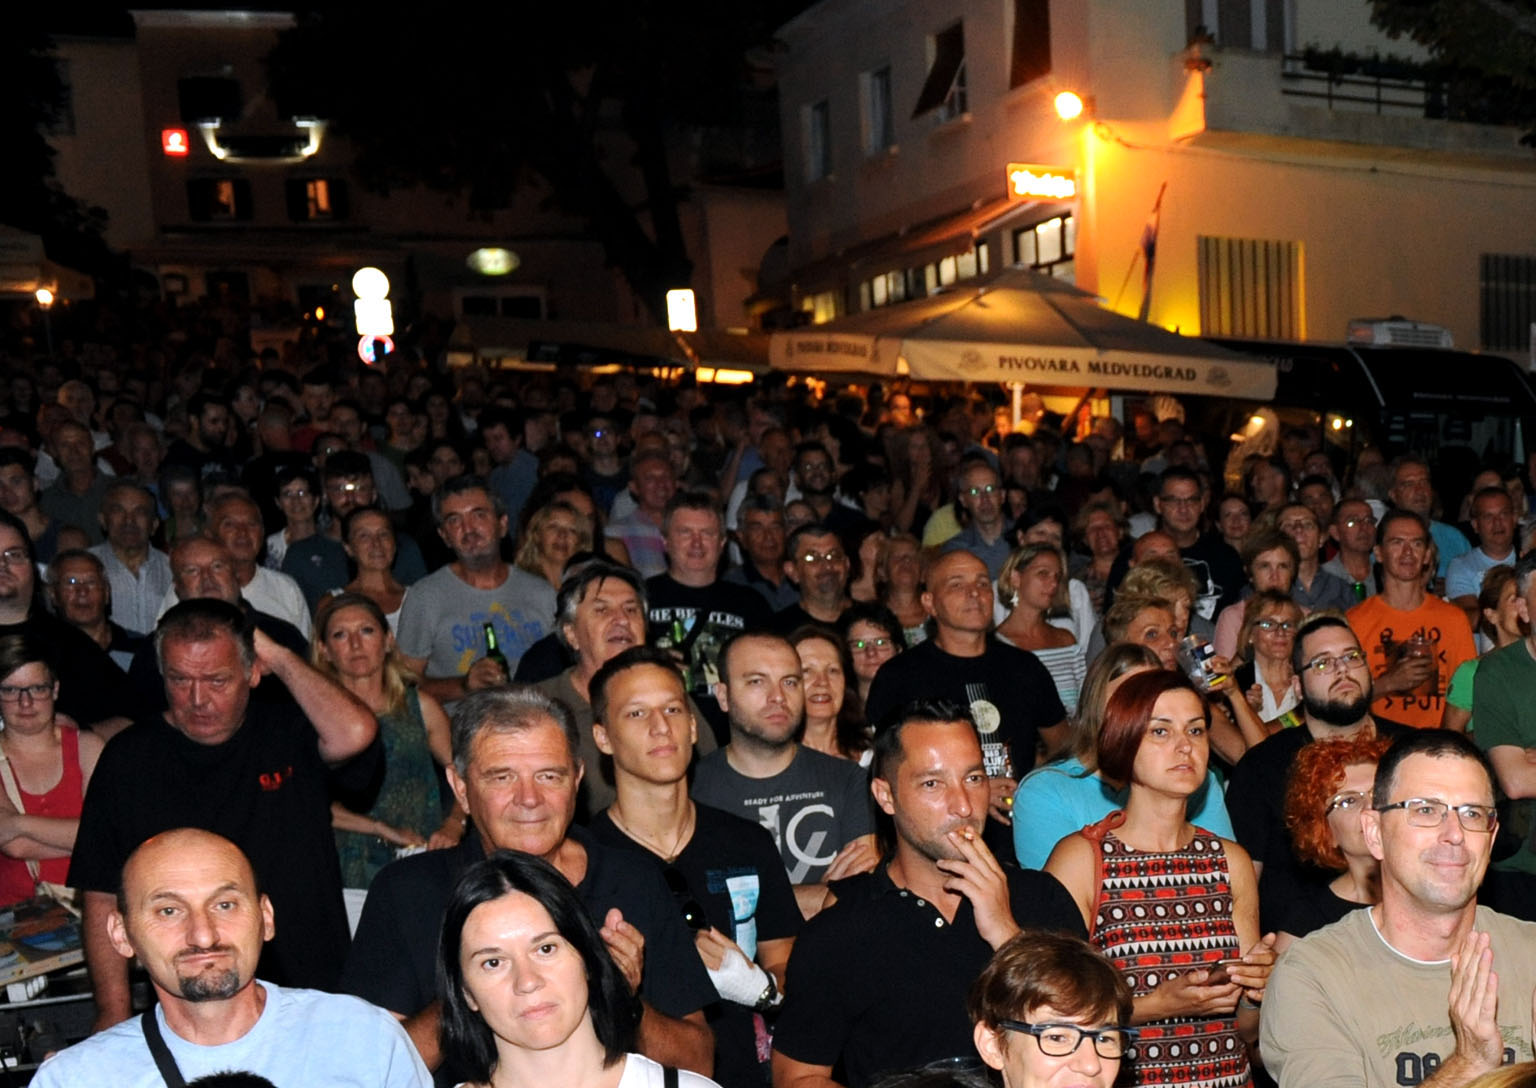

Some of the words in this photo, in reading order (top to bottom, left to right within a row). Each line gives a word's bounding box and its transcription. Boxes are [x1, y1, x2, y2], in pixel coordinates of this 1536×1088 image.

[999, 356, 1080, 373] PIVOVARA
[1088, 361, 1197, 382] MEDVEDGRAD
[649, 608, 672, 622] HE
[744, 798, 767, 806] READY
[770, 795, 784, 803] FOR
[785, 791, 825, 802] ADVENTURE
